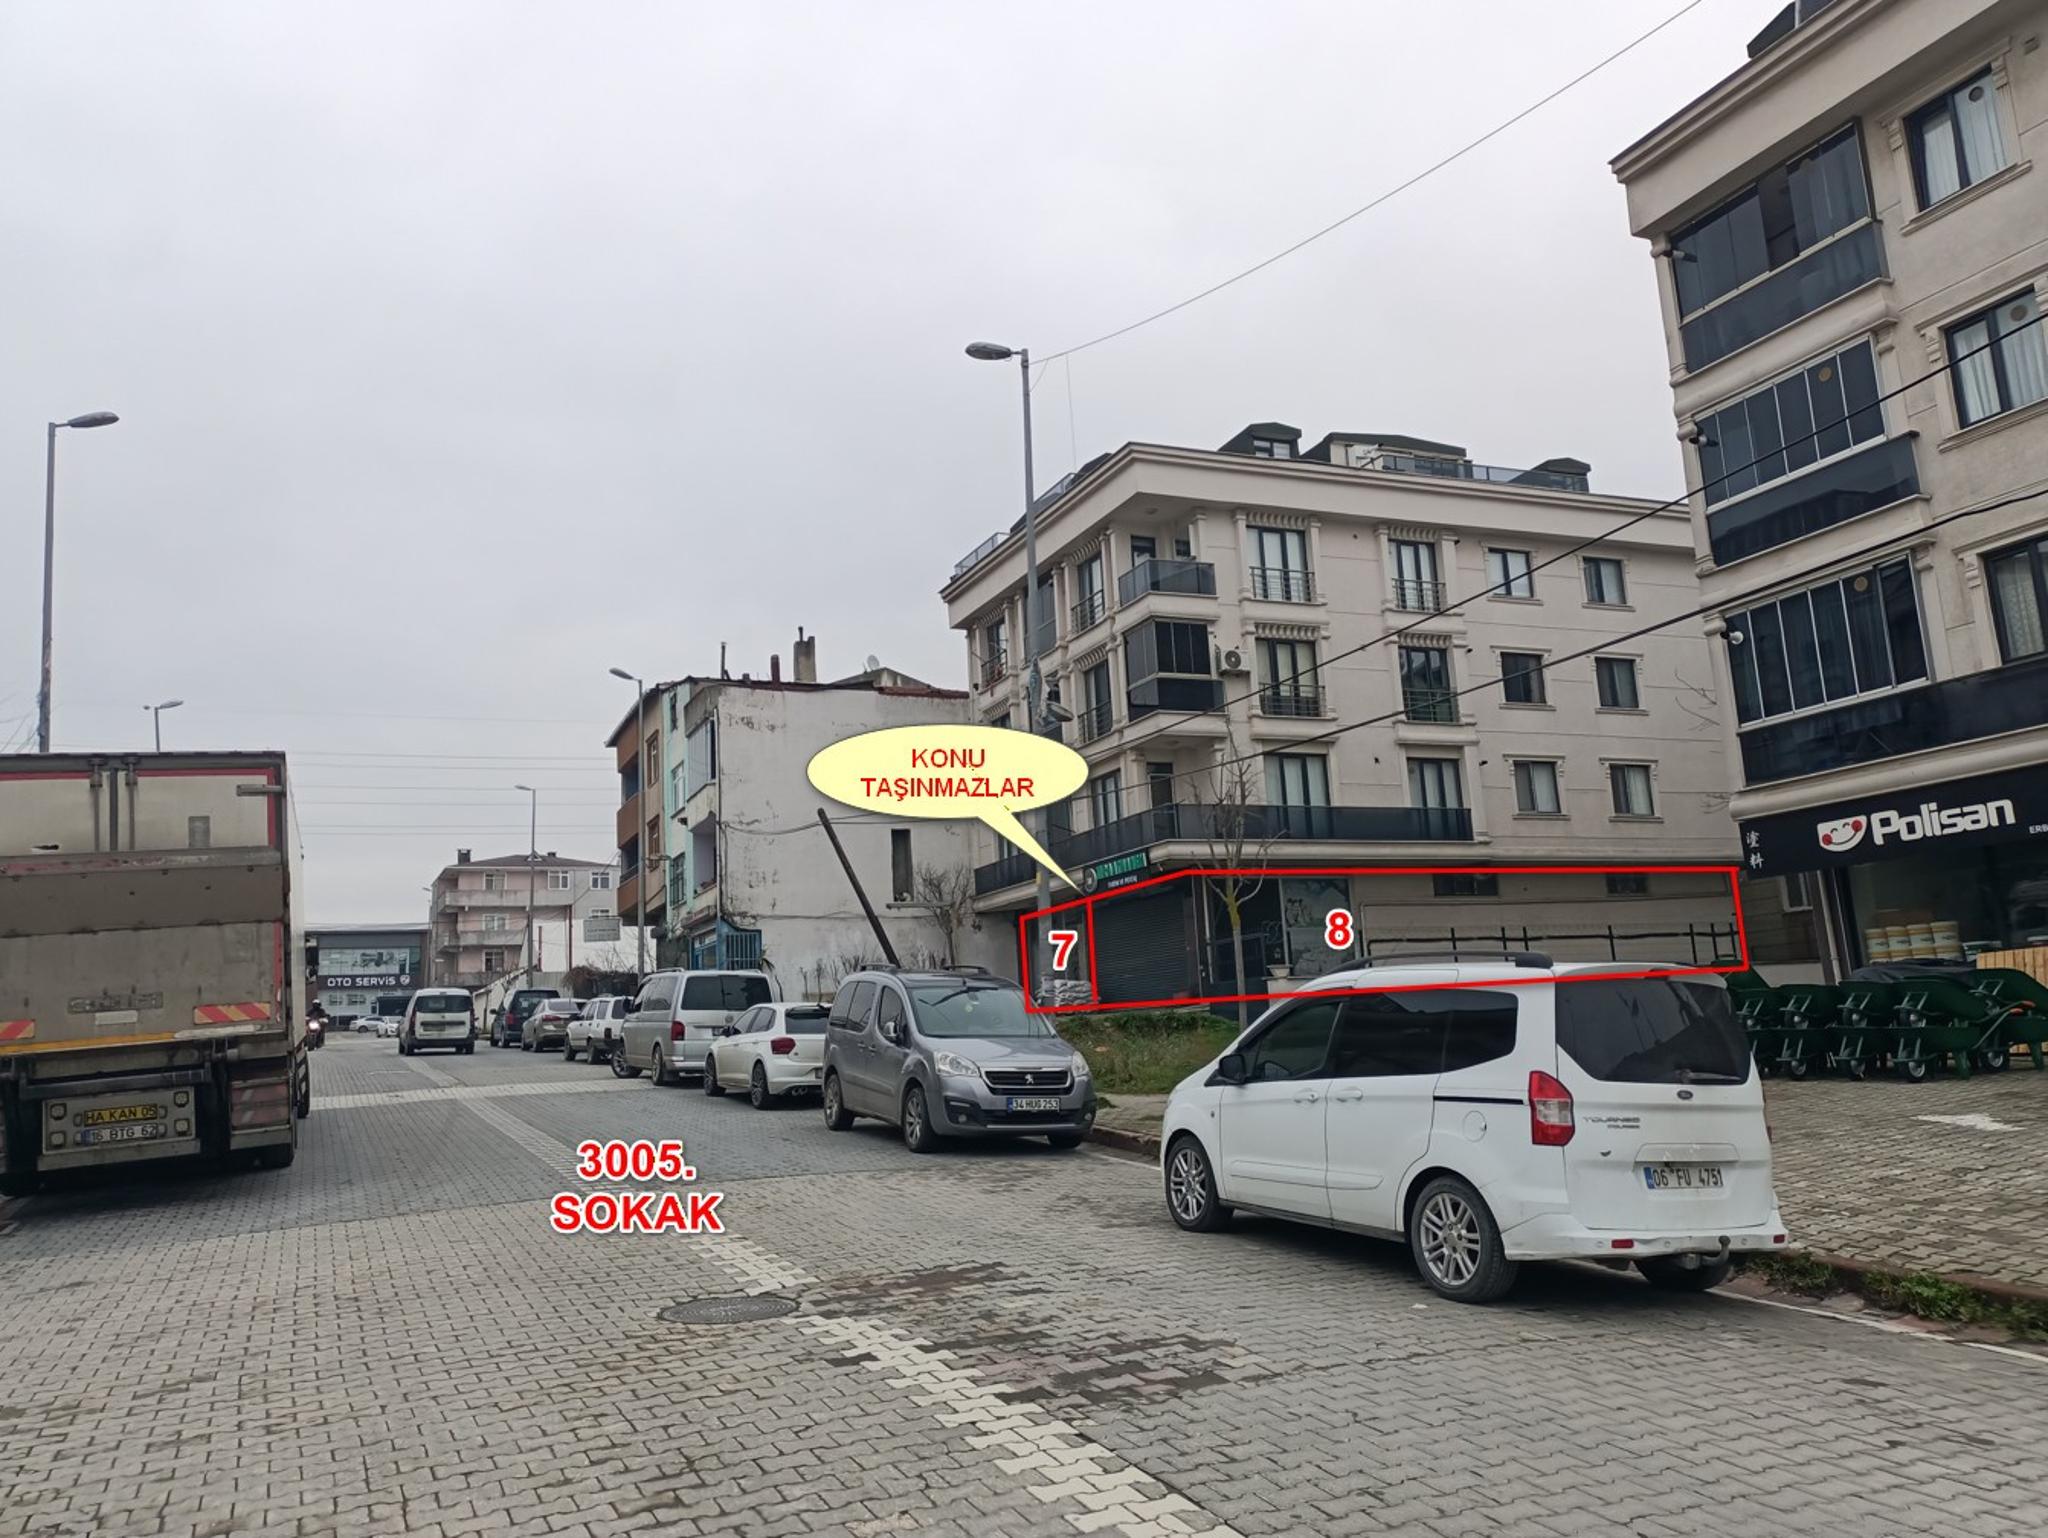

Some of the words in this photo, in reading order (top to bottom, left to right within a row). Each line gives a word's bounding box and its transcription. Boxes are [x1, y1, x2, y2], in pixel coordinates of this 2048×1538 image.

[1870, 799, 2016, 846] Polisan
[327, 977, 352, 987] OTO
[110, 1108, 136, 1121] KAN
[1653, 1168, 1669, 1186] 06
[1675, 1168, 1692, 1186] FU
[1698, 1167, 1724, 1186] 4751
